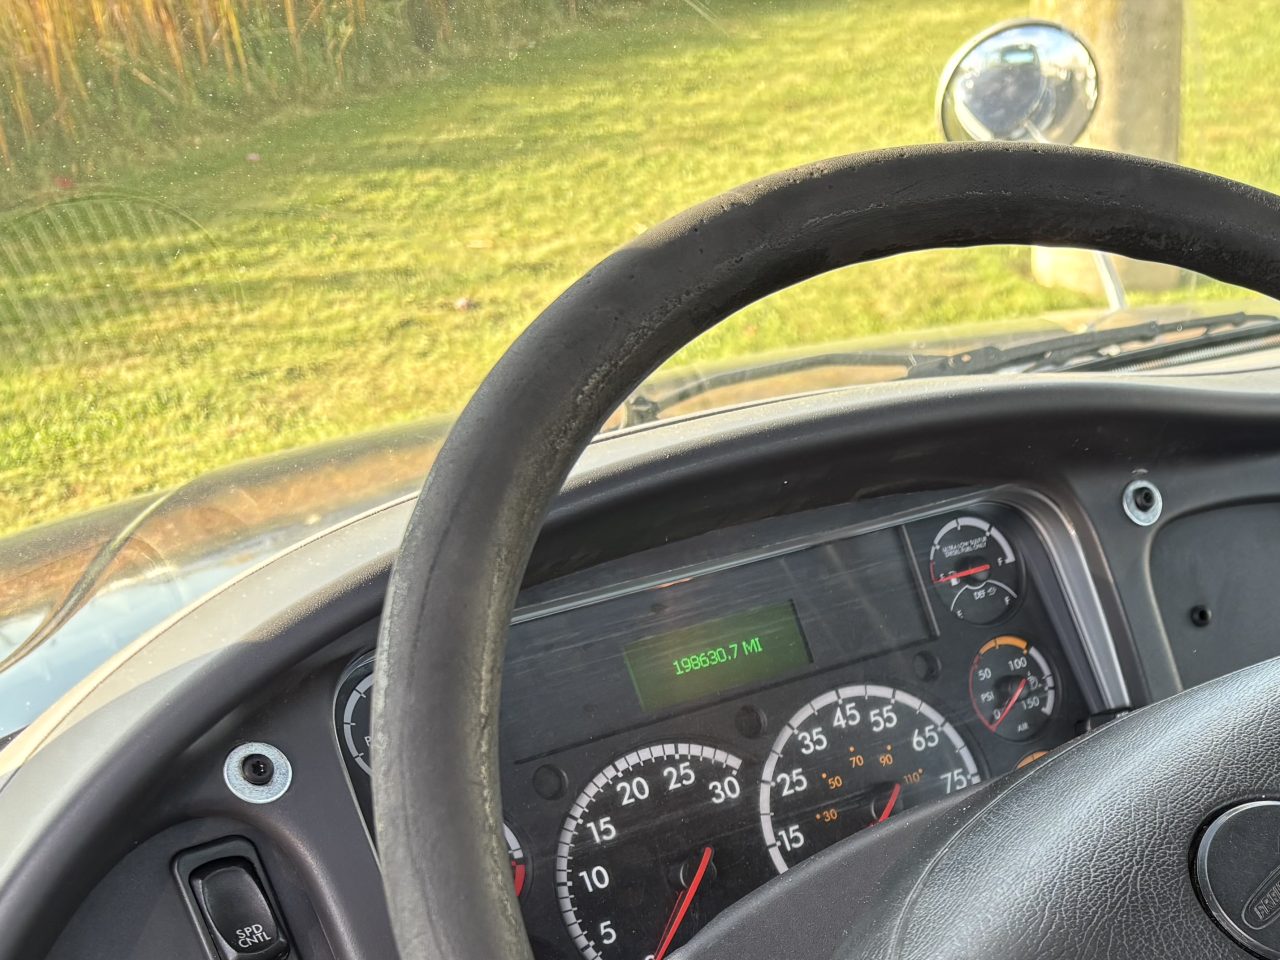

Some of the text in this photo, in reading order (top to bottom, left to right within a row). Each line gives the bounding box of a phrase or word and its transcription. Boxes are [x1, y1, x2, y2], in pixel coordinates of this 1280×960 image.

[673, 637, 763, 675] 198630.7 MI
[1008, 656, 1027, 672] 100
[978, 667, 992, 681] 50
[981, 690, 995, 703] PSI
[1021, 696, 1040, 710] 150
[833, 702, 861, 729] 45
[869, 705, 897, 732] 55
[798, 727, 828, 755] 35
[912, 725, 939, 751] 65
[849, 755, 864, 768] 70
[879, 754, 893, 767] 90
[663, 761, 695, 790] 25
[776, 768, 808, 798] 25
[828, 776, 843, 790] 50
[903, 772, 920, 785] 110
[940, 769, 968, 794] 75
[616, 776, 650, 806] 20
[708, 776, 741, 804] 30
[822, 808, 838, 822] 30
[586, 816, 617, 844] 15
[778, 825, 804, 851] 15
[578, 865, 610, 893] 10
[236, 924, 263, 939] SPD
[238, 931, 272, 948] CNTL
[600, 920, 617, 945] 5
